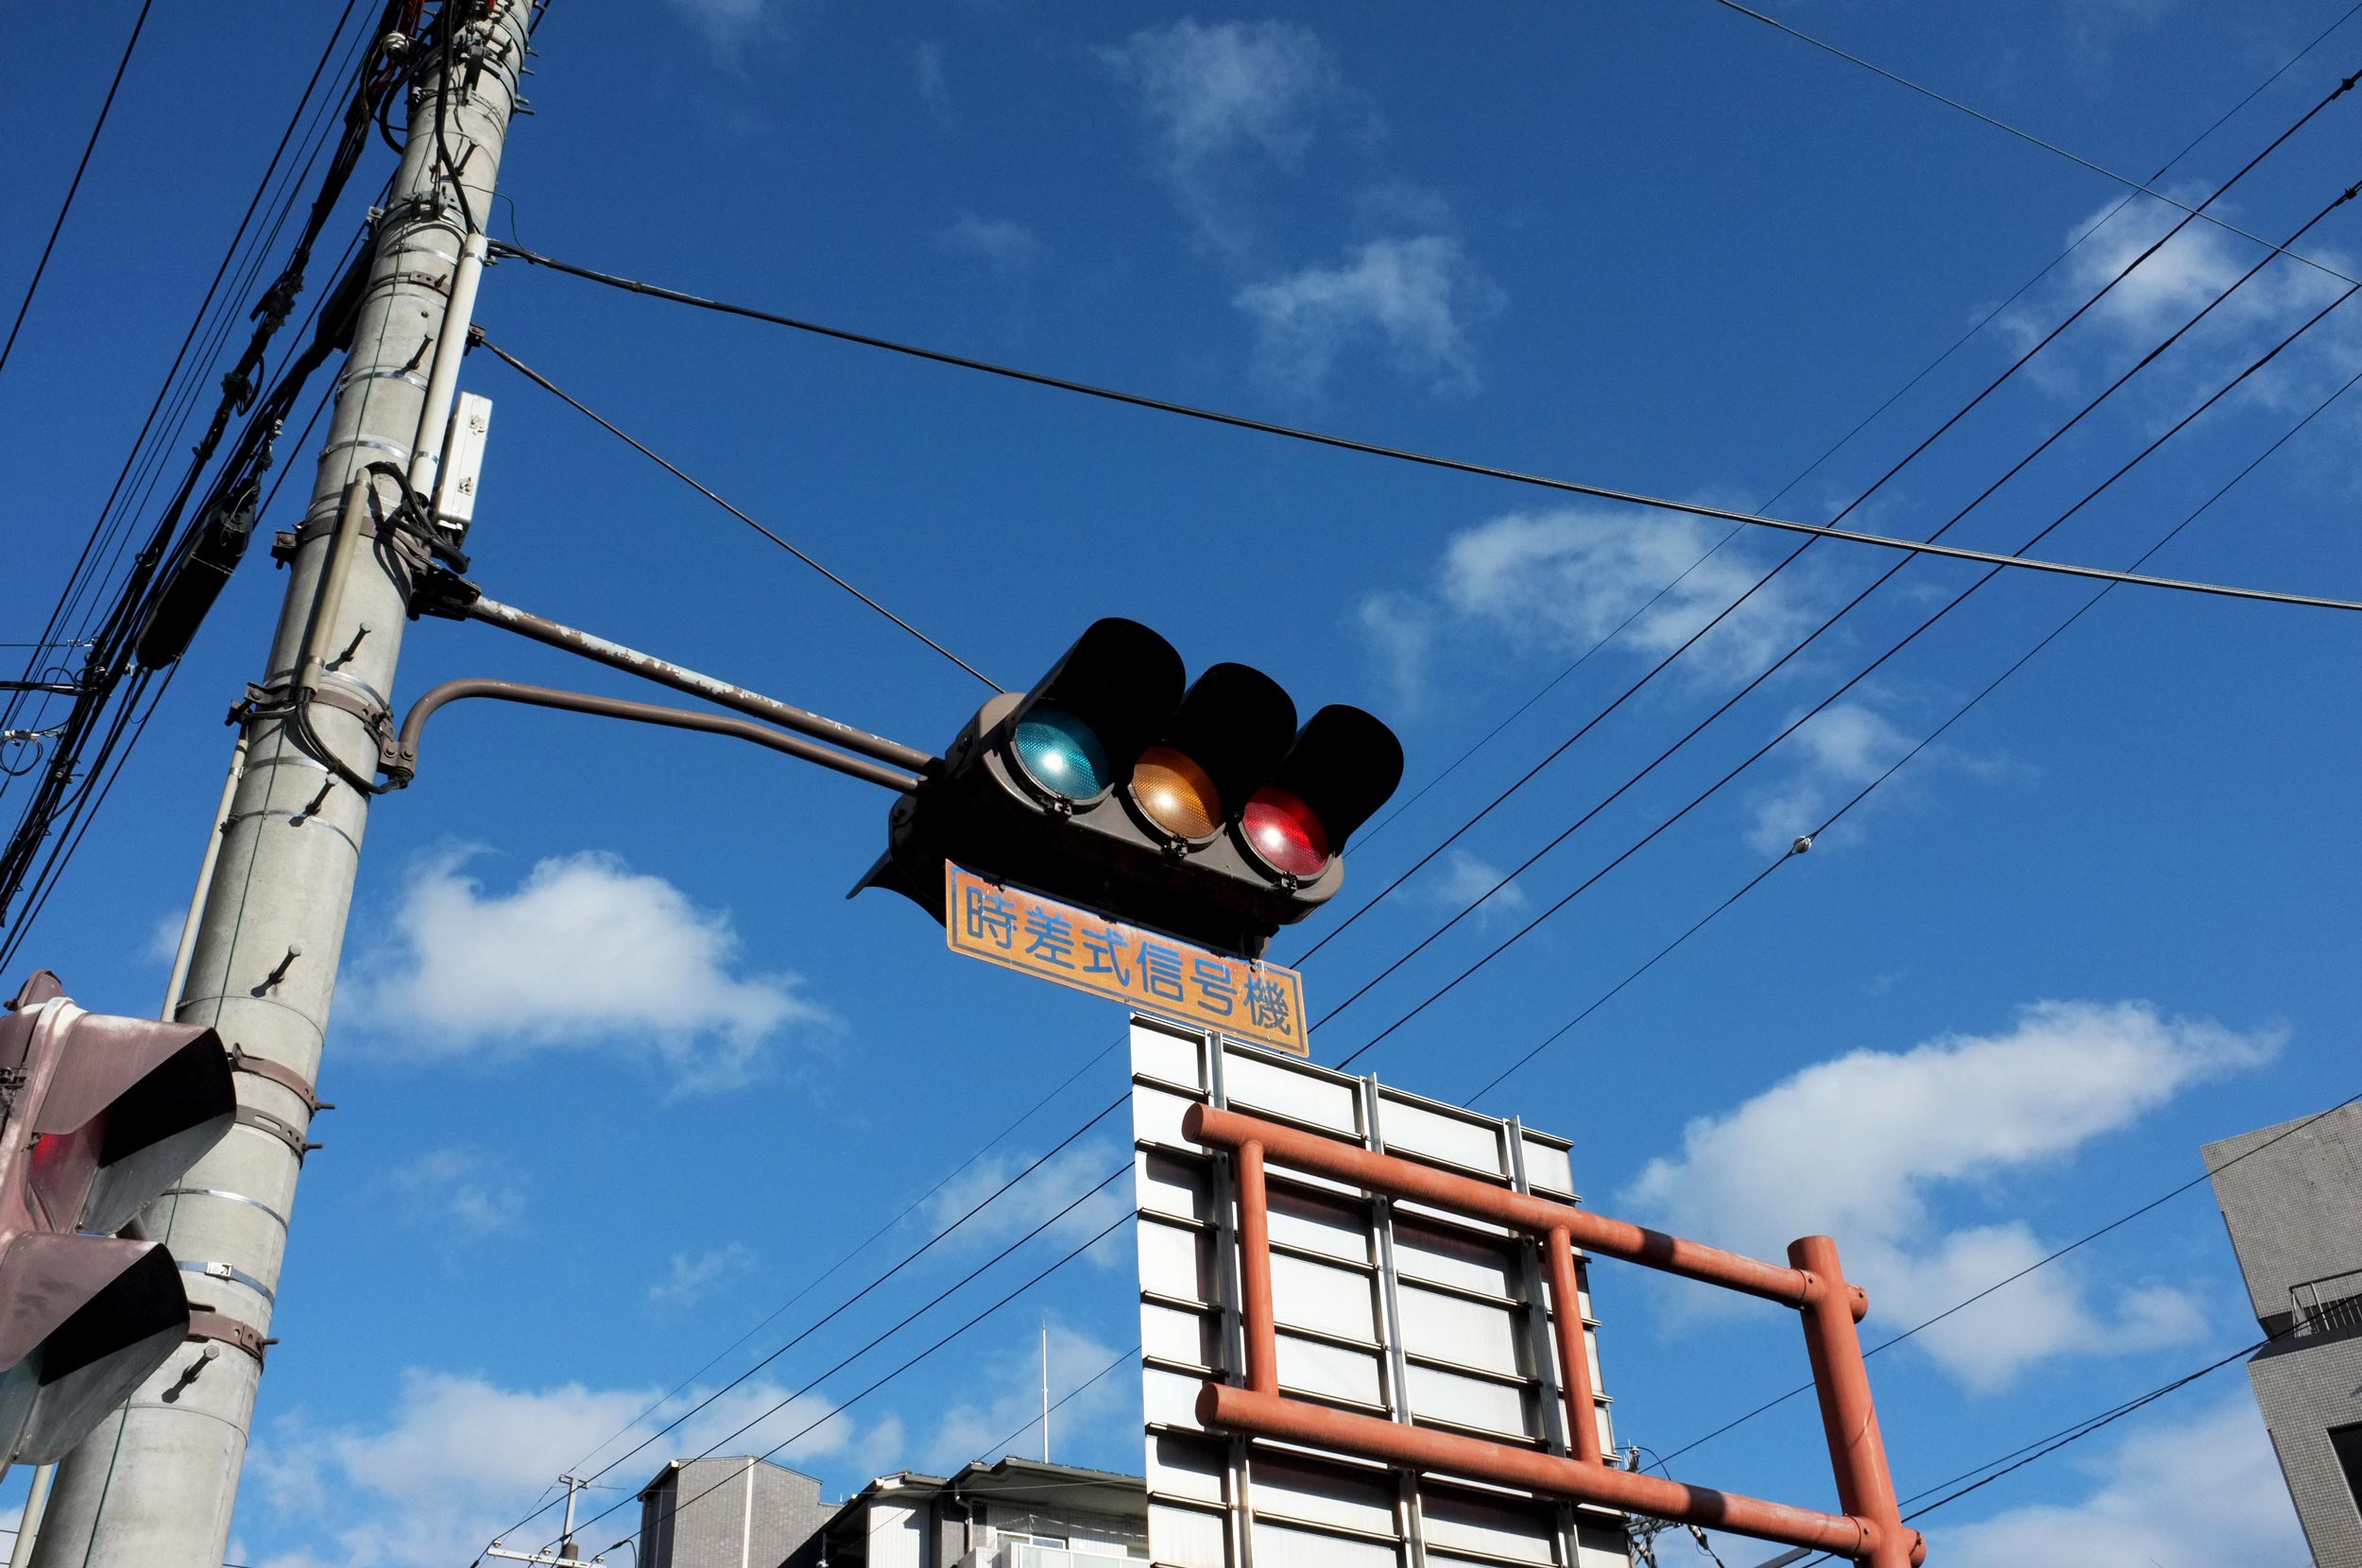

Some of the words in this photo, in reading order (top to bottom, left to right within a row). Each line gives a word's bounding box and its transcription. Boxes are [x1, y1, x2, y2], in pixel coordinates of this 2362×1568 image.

[967, 885, 1292, 1036] 時差式信号機
